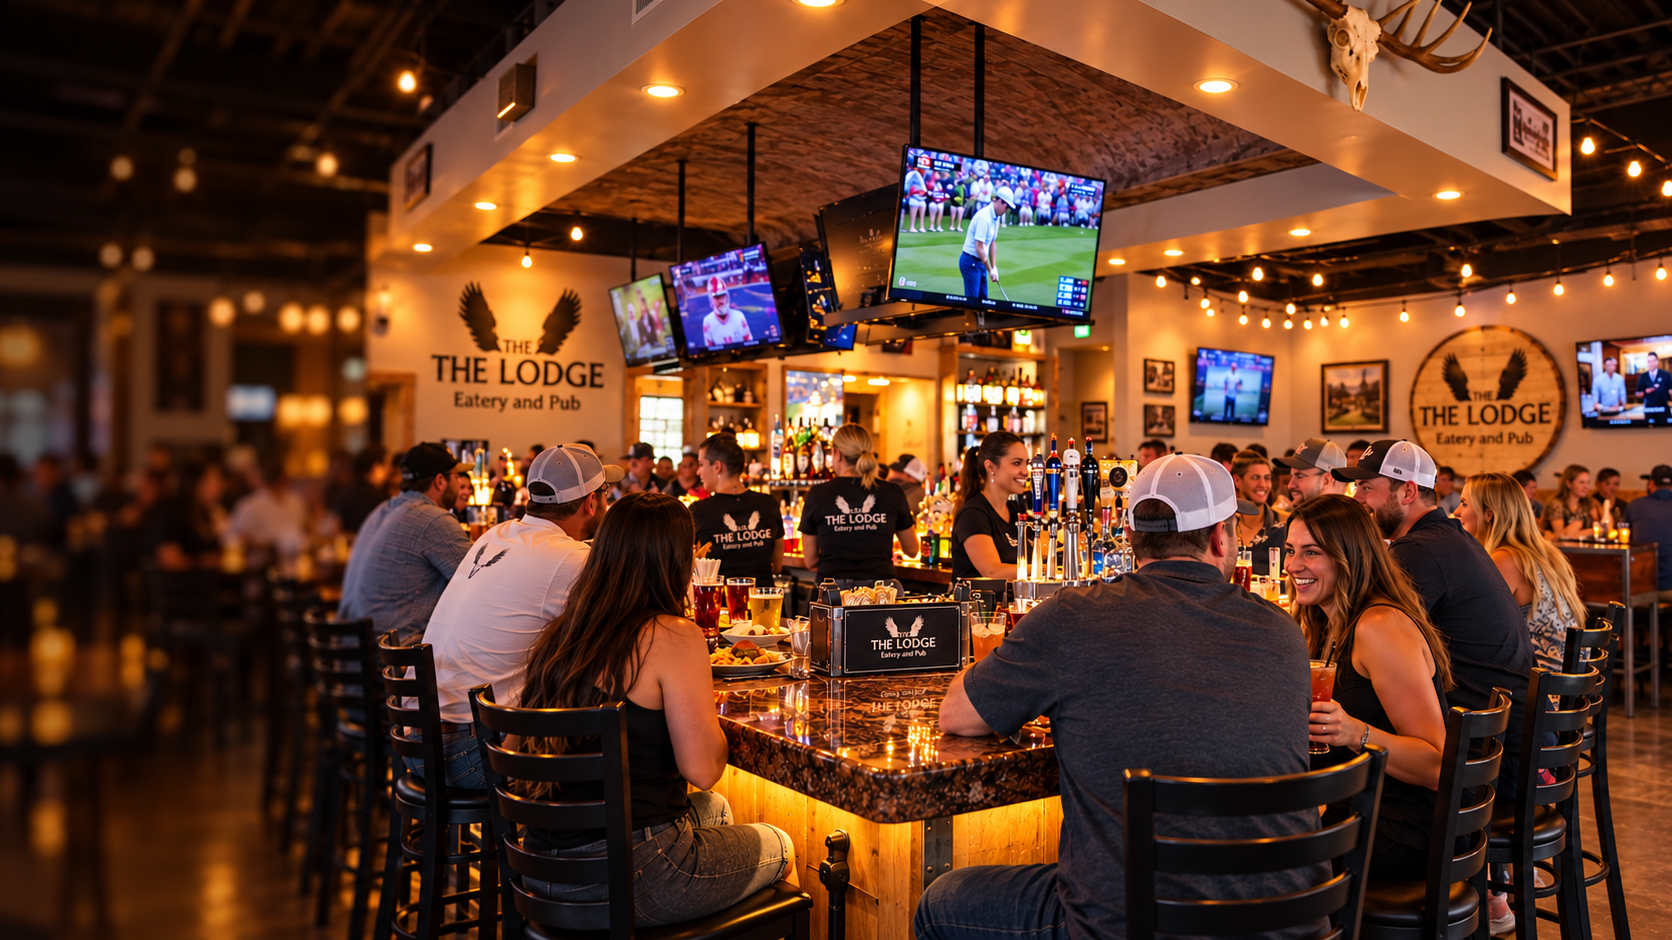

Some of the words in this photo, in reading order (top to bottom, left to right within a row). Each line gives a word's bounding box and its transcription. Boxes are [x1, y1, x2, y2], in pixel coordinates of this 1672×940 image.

[502, 339, 533, 355] THE
[431, 354, 488, 384] THE
[499, 358, 605, 389] LODGE
[454, 391, 508, 413] Eatery
[512, 395, 544, 410] and
[549, 395, 581, 411] Pub
[1472, 390, 1494, 402] THE
[1419, 405, 1459, 426] THE
[1467, 402, 1552, 426] LODGE
[1436, 432, 1476, 447] Eatery
[1478, 431, 1503, 445] and
[1507, 431, 1534, 445] Pub
[824, 514, 845, 525] THE
[848, 512, 886, 523] LODGE
[712, 532, 734, 543] THE
[736, 528, 771, 541] LODGE
[870, 638, 892, 650] THE
[896, 636, 935, 649] LODGE
